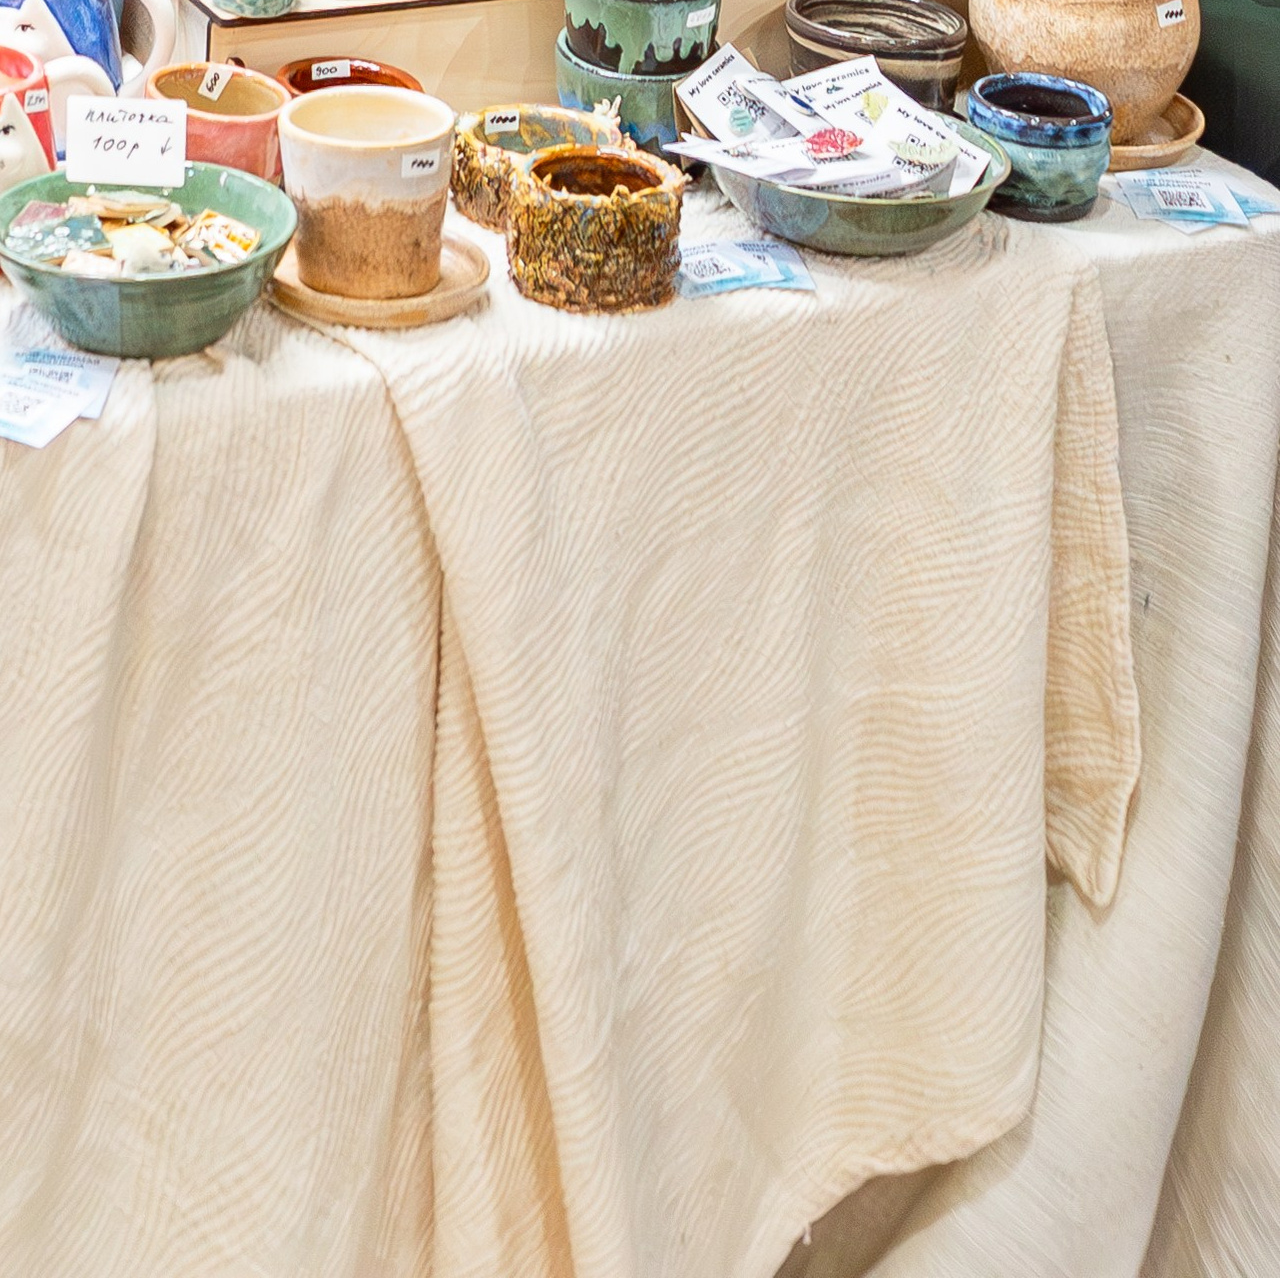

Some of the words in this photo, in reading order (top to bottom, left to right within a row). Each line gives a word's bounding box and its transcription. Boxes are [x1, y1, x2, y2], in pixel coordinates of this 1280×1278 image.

[315, 66, 339, 76] 900
[205, 71, 221, 93] 600
[488, 115, 517, 124] 1000
